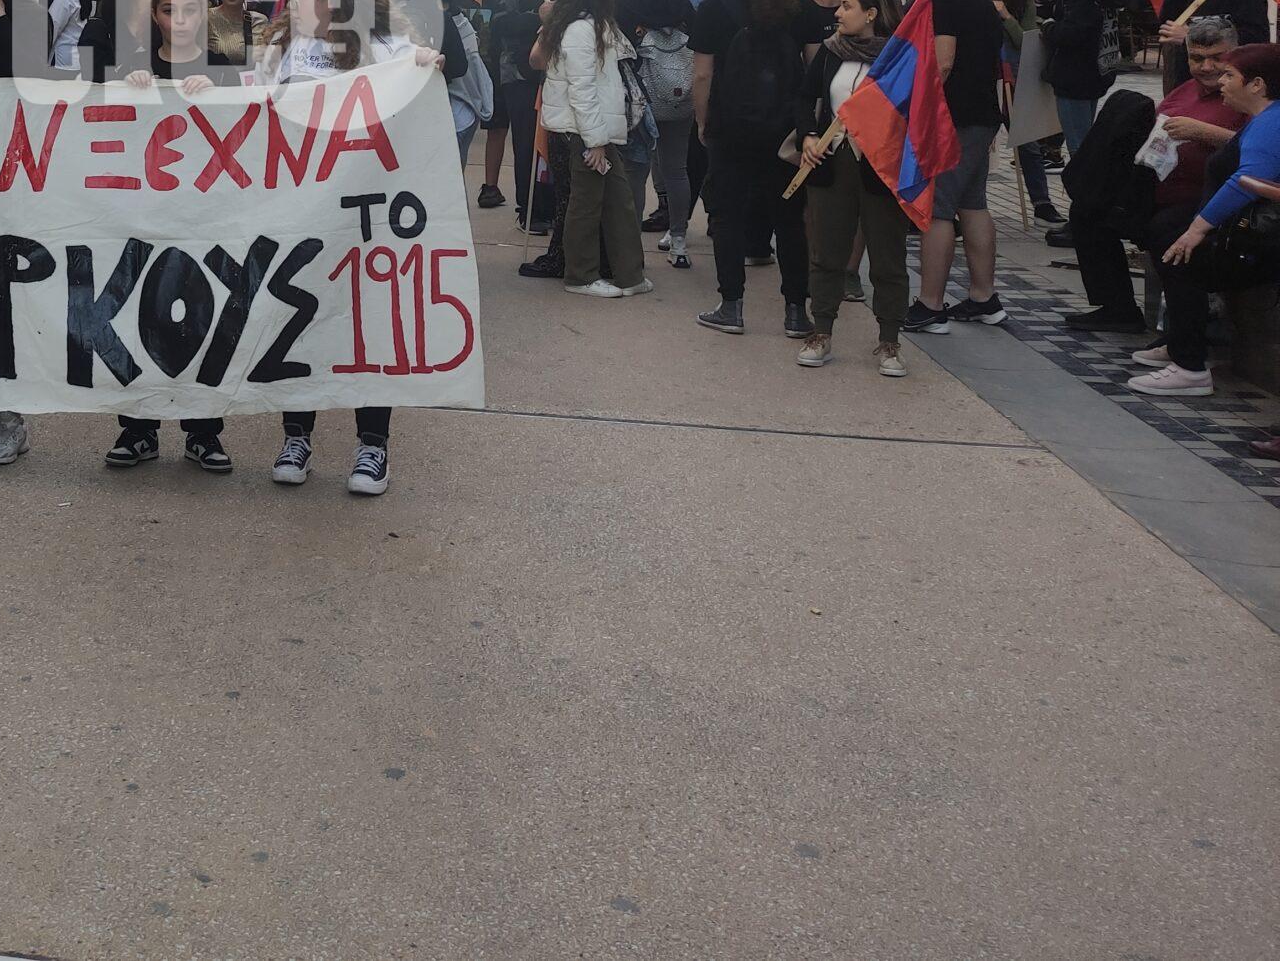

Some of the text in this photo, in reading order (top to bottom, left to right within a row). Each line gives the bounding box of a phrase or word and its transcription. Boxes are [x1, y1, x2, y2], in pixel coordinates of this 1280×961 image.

[82, 74, 400, 191] ΞΕΧΝΑ
[340, 192, 427, 240] ΤΟ
[328, 244, 474, 375] 1915
